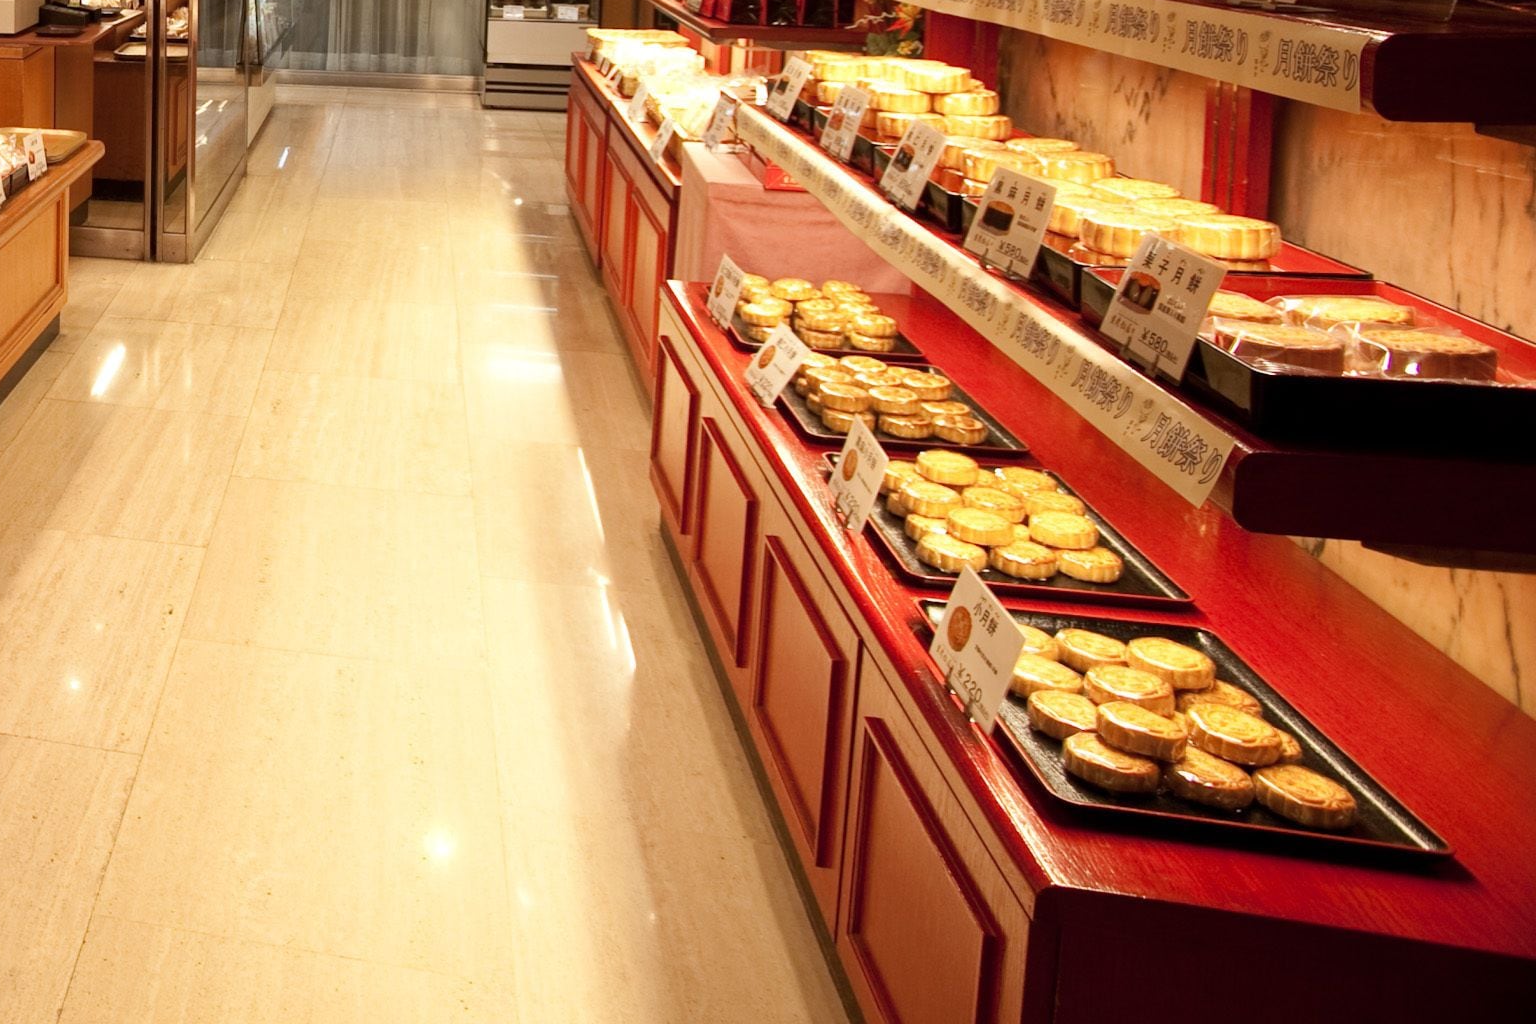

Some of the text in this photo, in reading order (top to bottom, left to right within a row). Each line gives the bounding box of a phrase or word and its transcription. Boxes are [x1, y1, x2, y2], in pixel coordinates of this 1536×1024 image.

[1105, 4, 1161, 44] 月餅祭り
[1181, 19, 1250, 66] 月餅祭り
[1273, 38, 1358, 92] 月餅祭り
[1142, 251, 1203, 296] 栗子月餅
[1141, 327, 1168, 354] ¥580
[1070, 358, 1134, 420] 月餅祭り
[1140, 412, 1223, 485] 月餅祭り
[973, 602, 999, 638] 小月餅
[957, 663, 983, 704] ¥220
